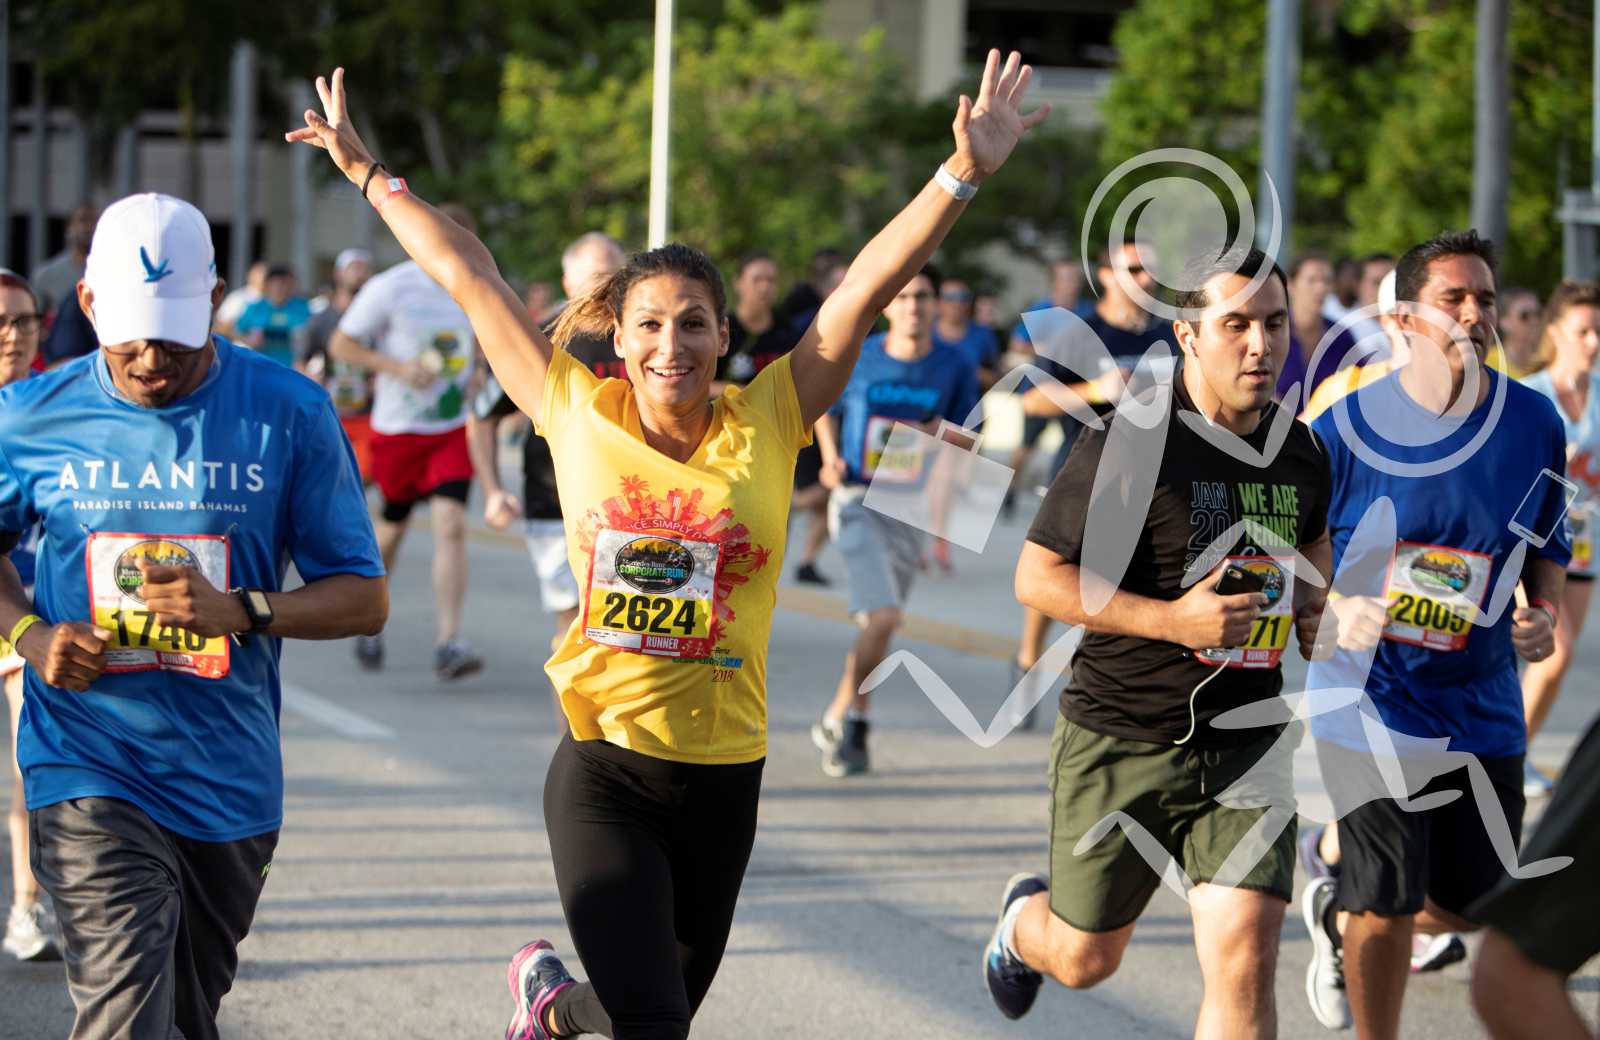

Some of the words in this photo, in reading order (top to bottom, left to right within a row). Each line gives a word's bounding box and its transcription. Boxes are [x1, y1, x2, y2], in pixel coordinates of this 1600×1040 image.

[59, 460, 265, 492] ATLANTIS
[73, 500, 132, 510] PARADISE
[138, 501, 184, 511] ISLAND
[190, 501, 249, 513] BAHAMAS
[1191, 482, 1229, 509] JAN
[1238, 482, 1268, 513] WE
[1272, 484, 1300, 515] ARE
[653, 520, 692, 533] SIMPLY
[1242, 514, 1297, 548] TENNIS
[602, 591, 696, 635] 2624
[1394, 594, 1466, 632] 2005
[646, 636, 679, 649] RUNNER
